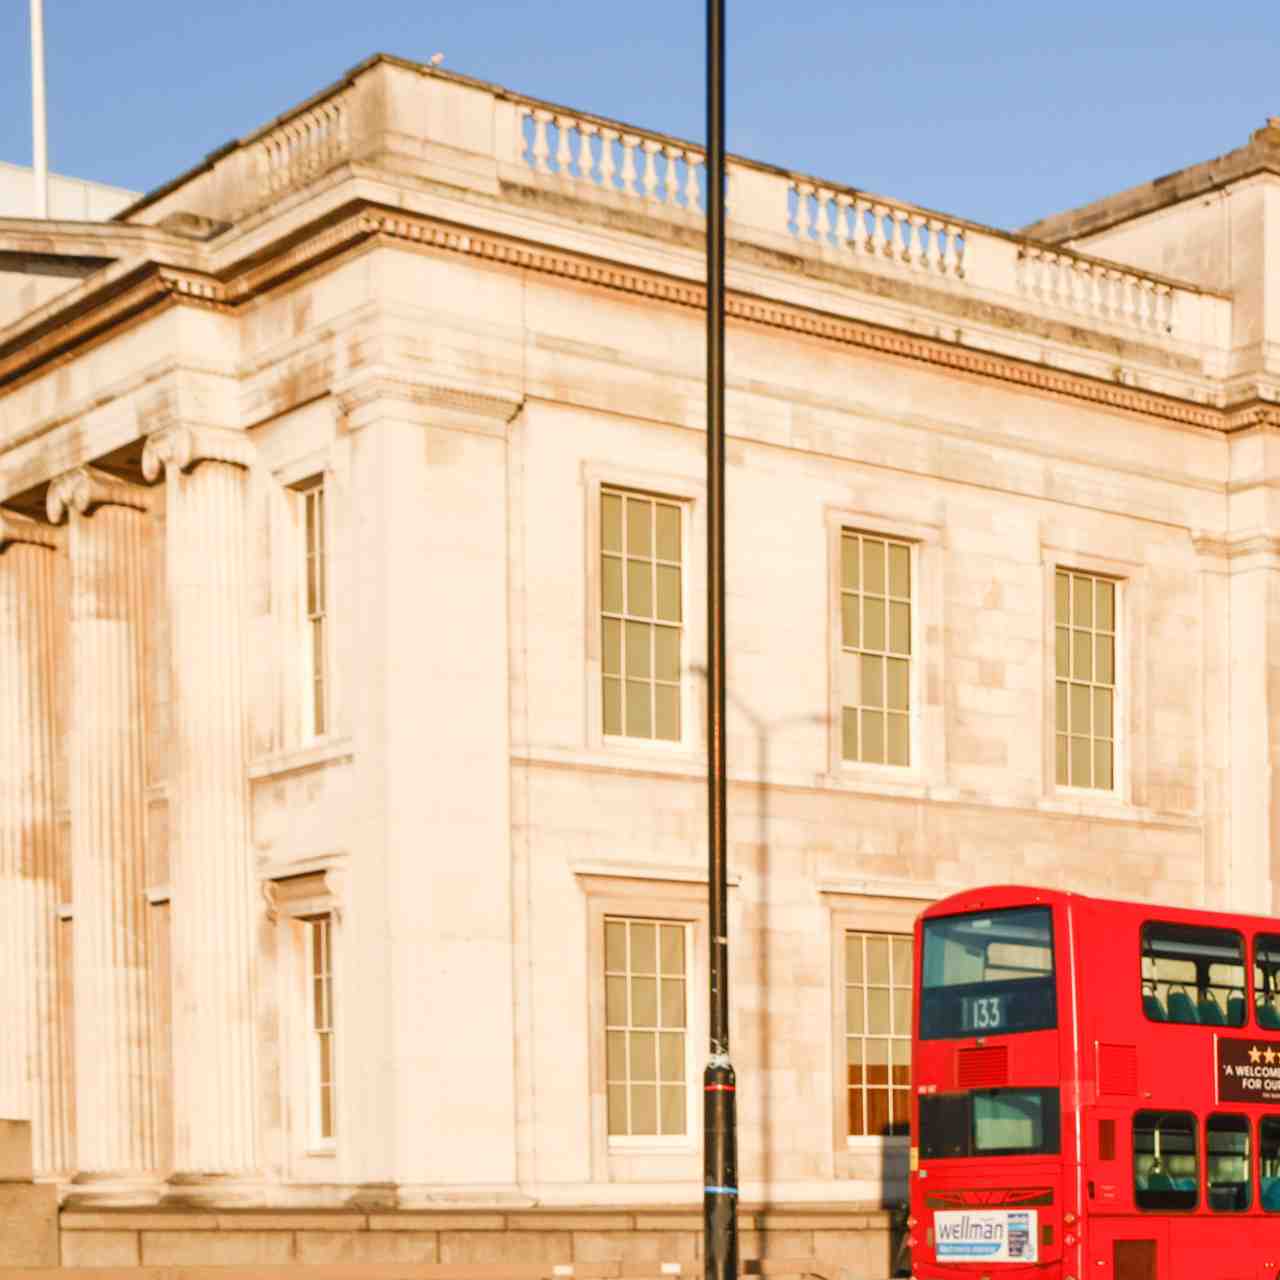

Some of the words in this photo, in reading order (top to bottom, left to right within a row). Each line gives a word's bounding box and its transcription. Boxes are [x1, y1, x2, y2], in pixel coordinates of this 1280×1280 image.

[972, 997, 1001, 1029] 133
[1242, 1078, 1262, 1090] FOR
[939, 1215, 1003, 1240] wellman
